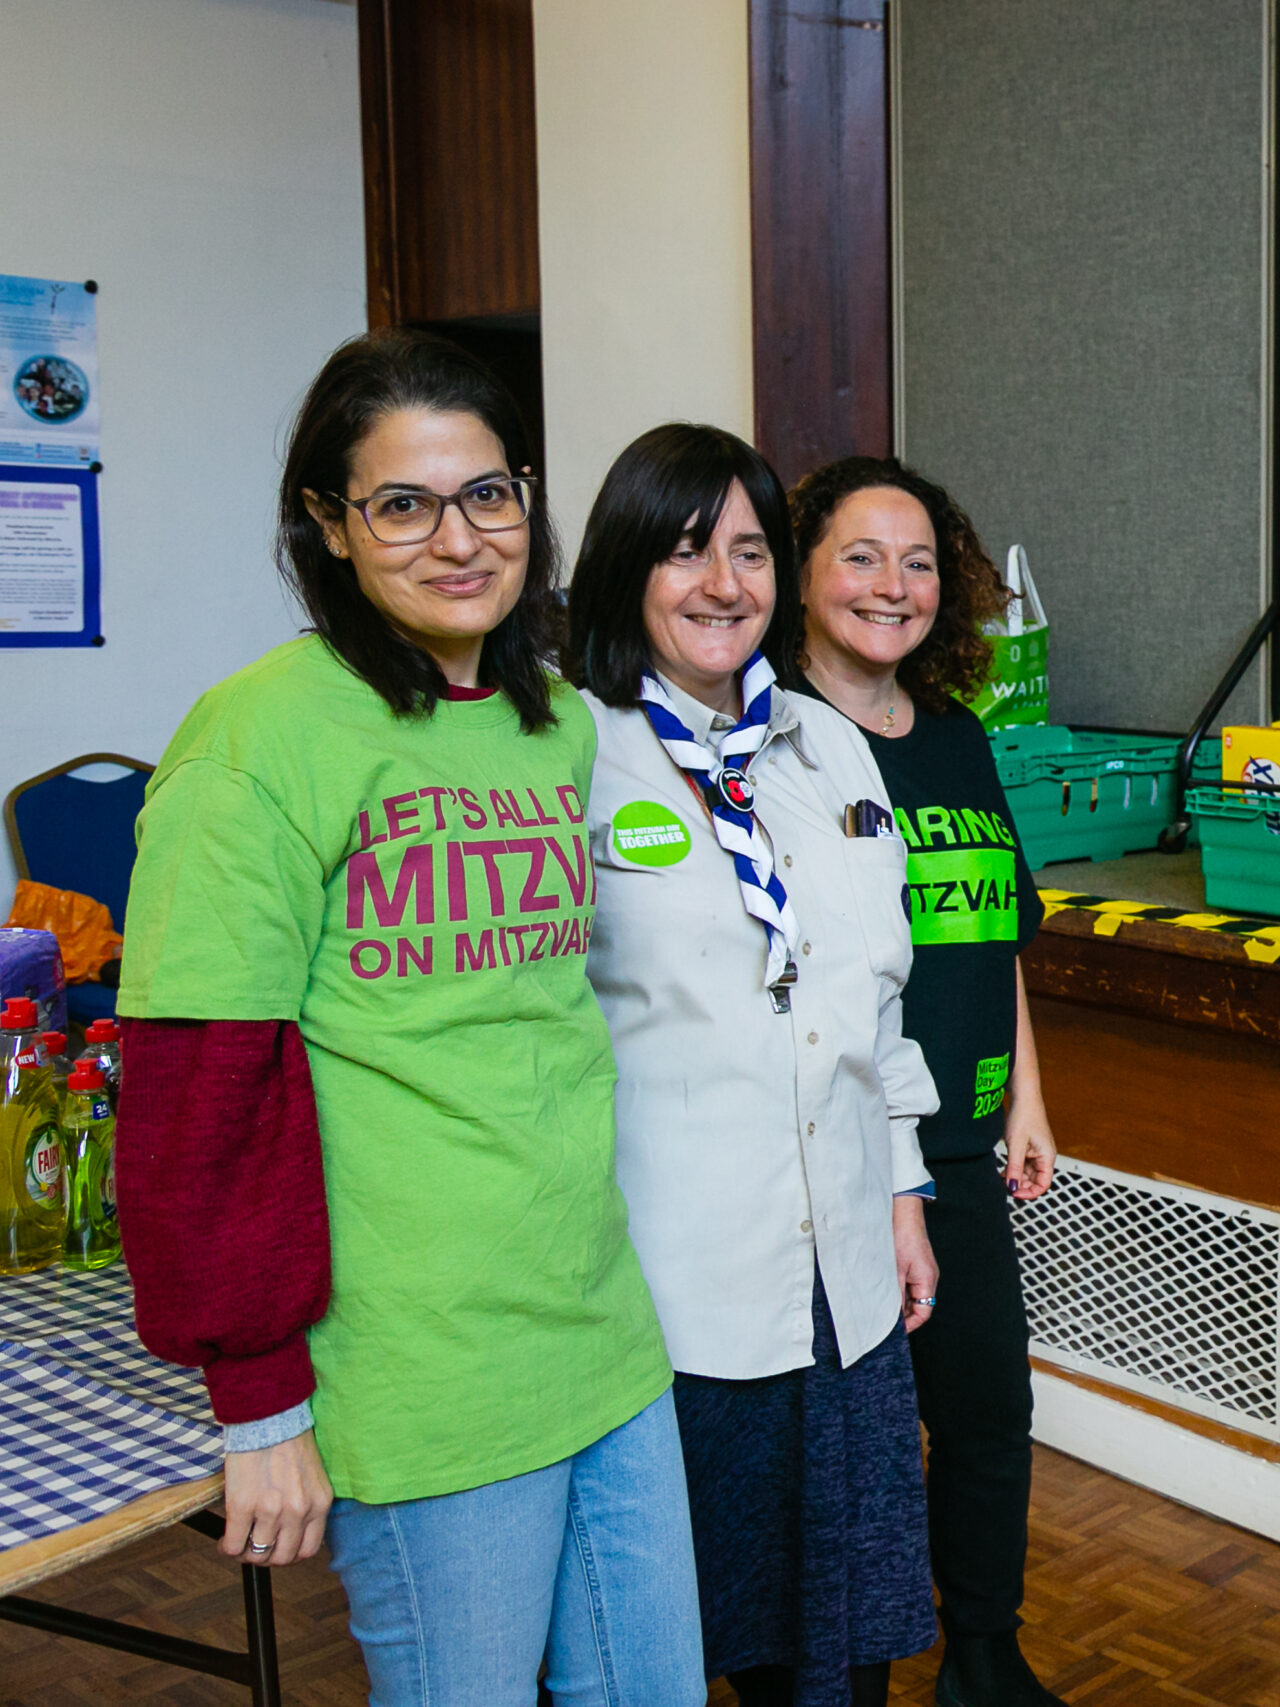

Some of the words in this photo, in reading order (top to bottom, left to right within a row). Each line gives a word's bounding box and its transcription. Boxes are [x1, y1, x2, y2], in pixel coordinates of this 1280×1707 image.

[991, 675, 1049, 698] WAIT
[358, 786, 488, 849] LET'S
[489, 788, 560, 828] ALL
[555, 784, 585, 824] D
[893, 806, 1017, 848] ARING
[619, 832, 687, 850] TOGETHER
[346, 835, 597, 929] MITZV
[909, 879, 1019, 913] TZVAH
[350, 936, 433, 980] ON
[18, 1054, 34, 1065] NEW
